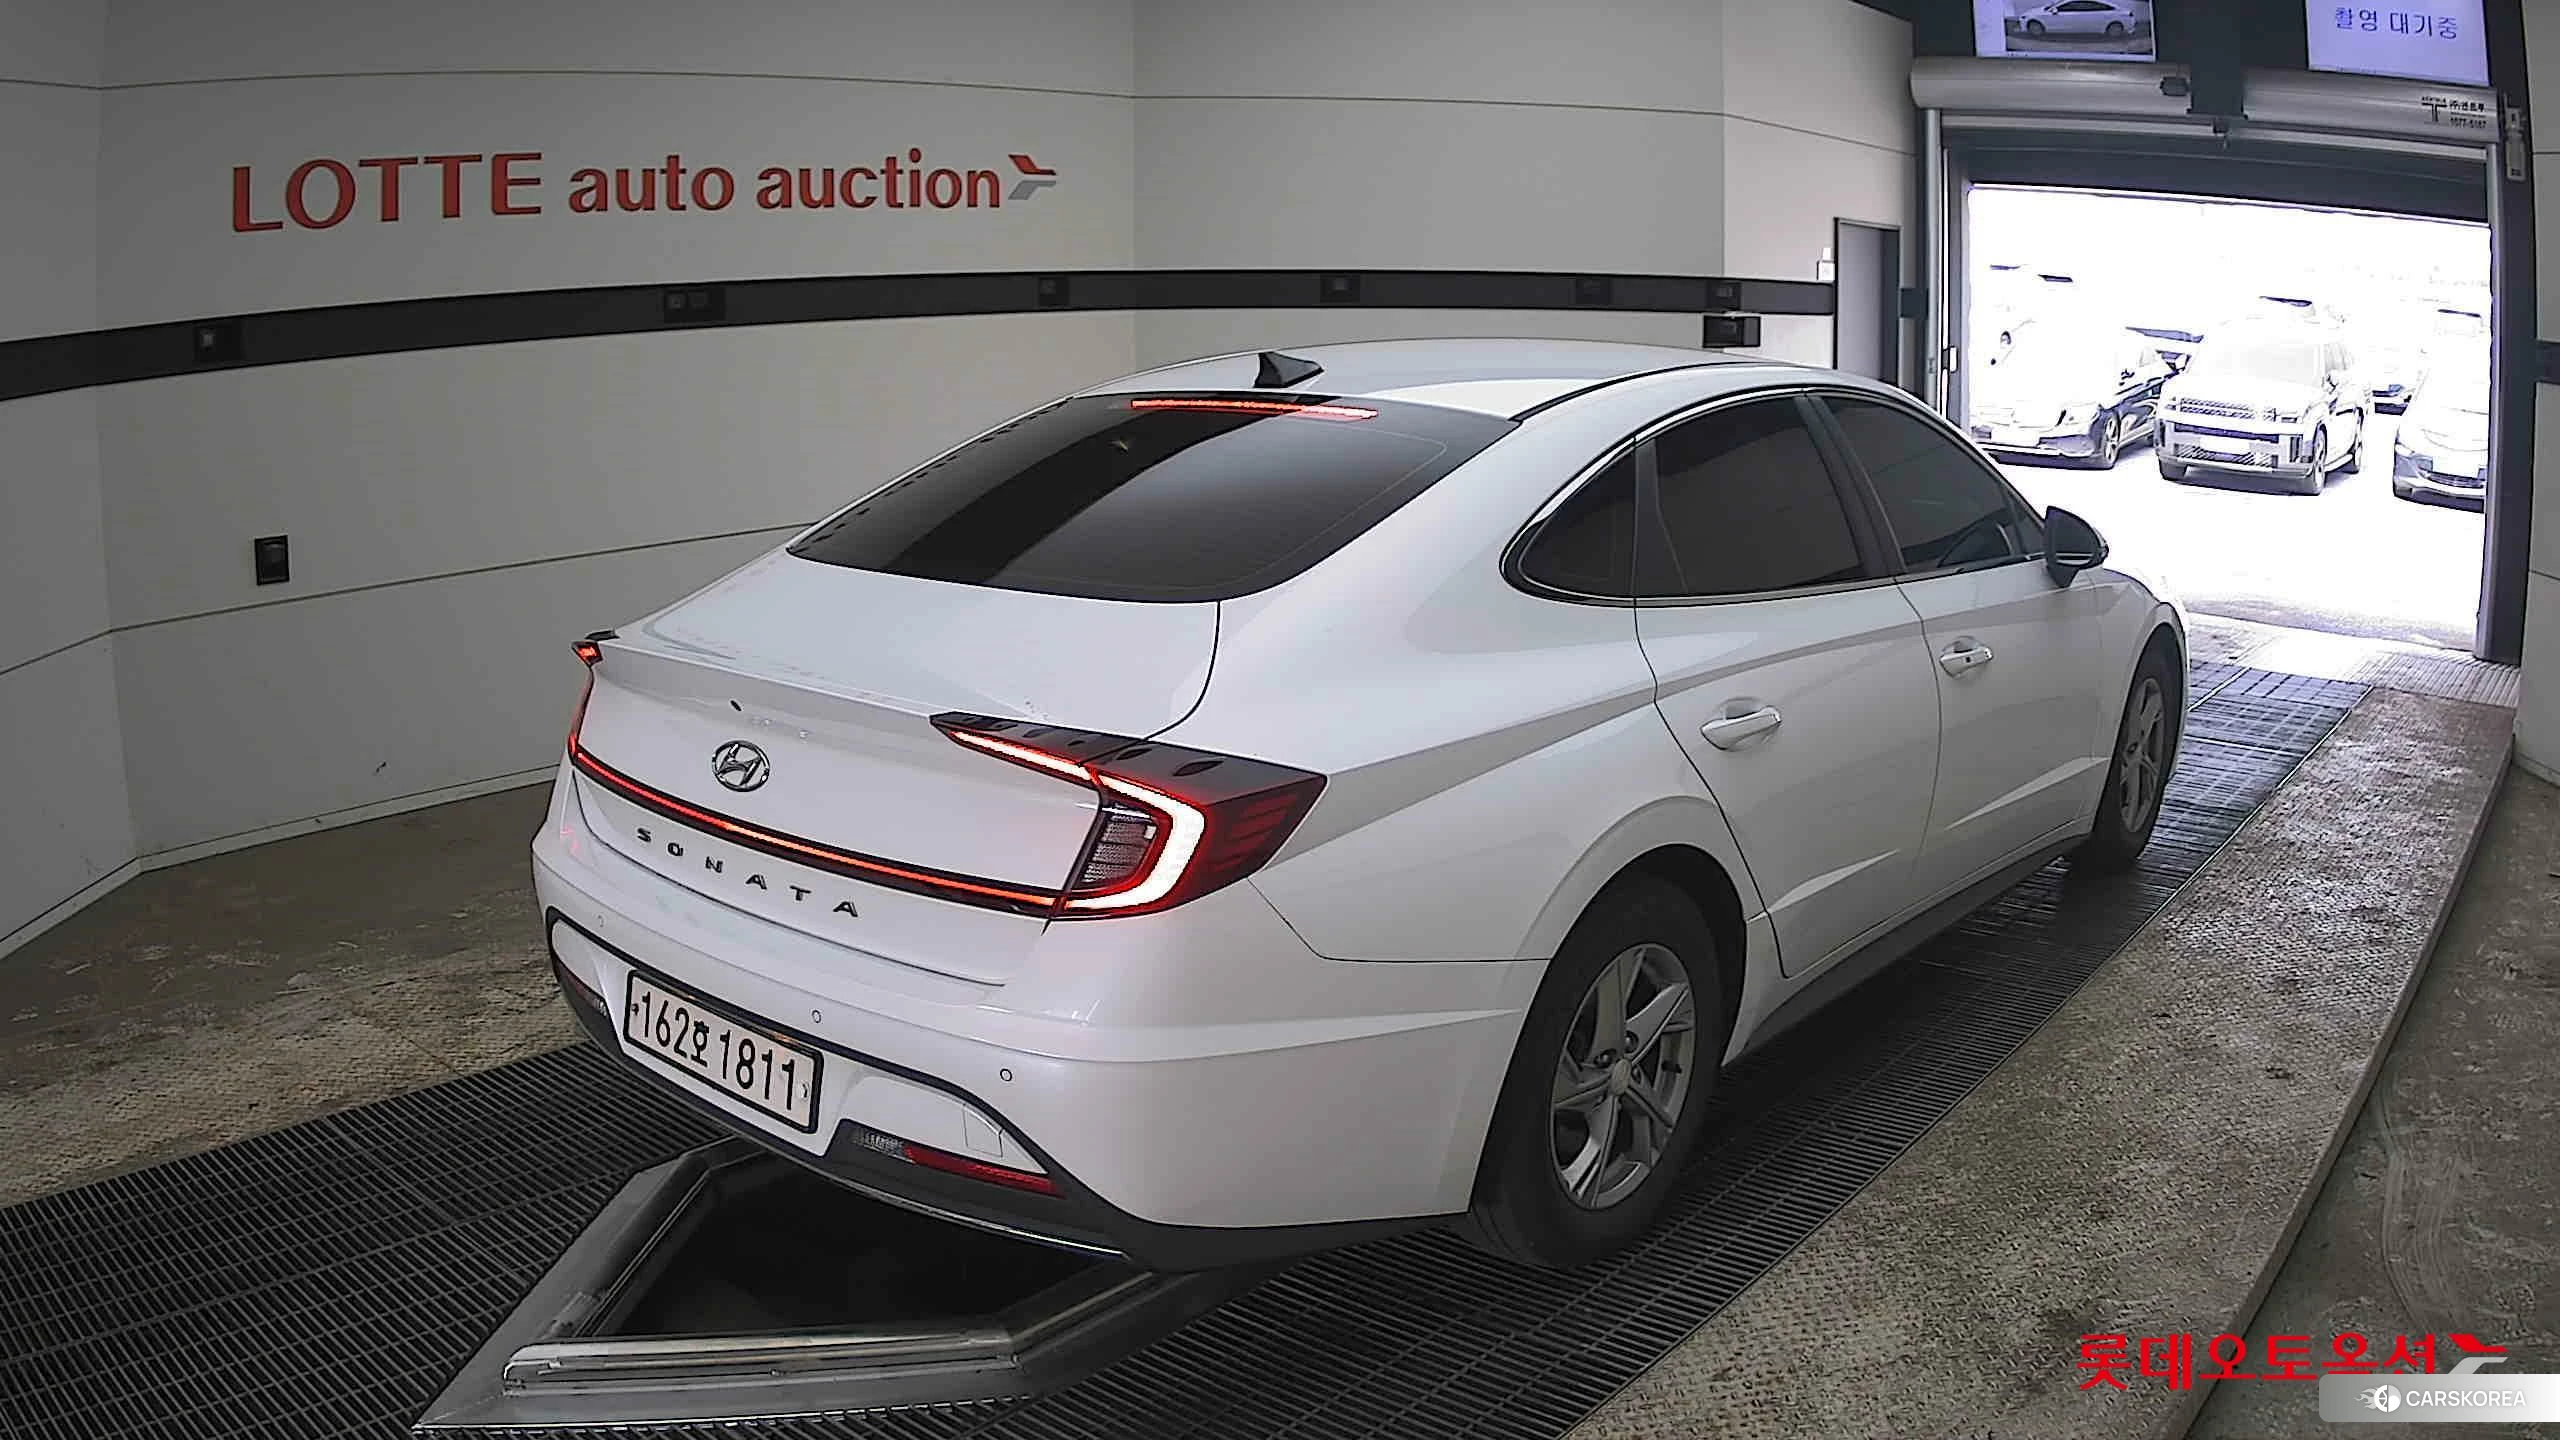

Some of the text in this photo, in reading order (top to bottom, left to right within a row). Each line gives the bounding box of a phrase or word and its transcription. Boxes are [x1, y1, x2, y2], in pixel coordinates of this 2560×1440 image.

[2335, 7, 2458, 40] 촬영 대기중
[233, 147, 1002, 232] LOTTE auto auction
[637, 827, 859, 918] SONATA
[641, 991, 796, 1111] 162호 1811
